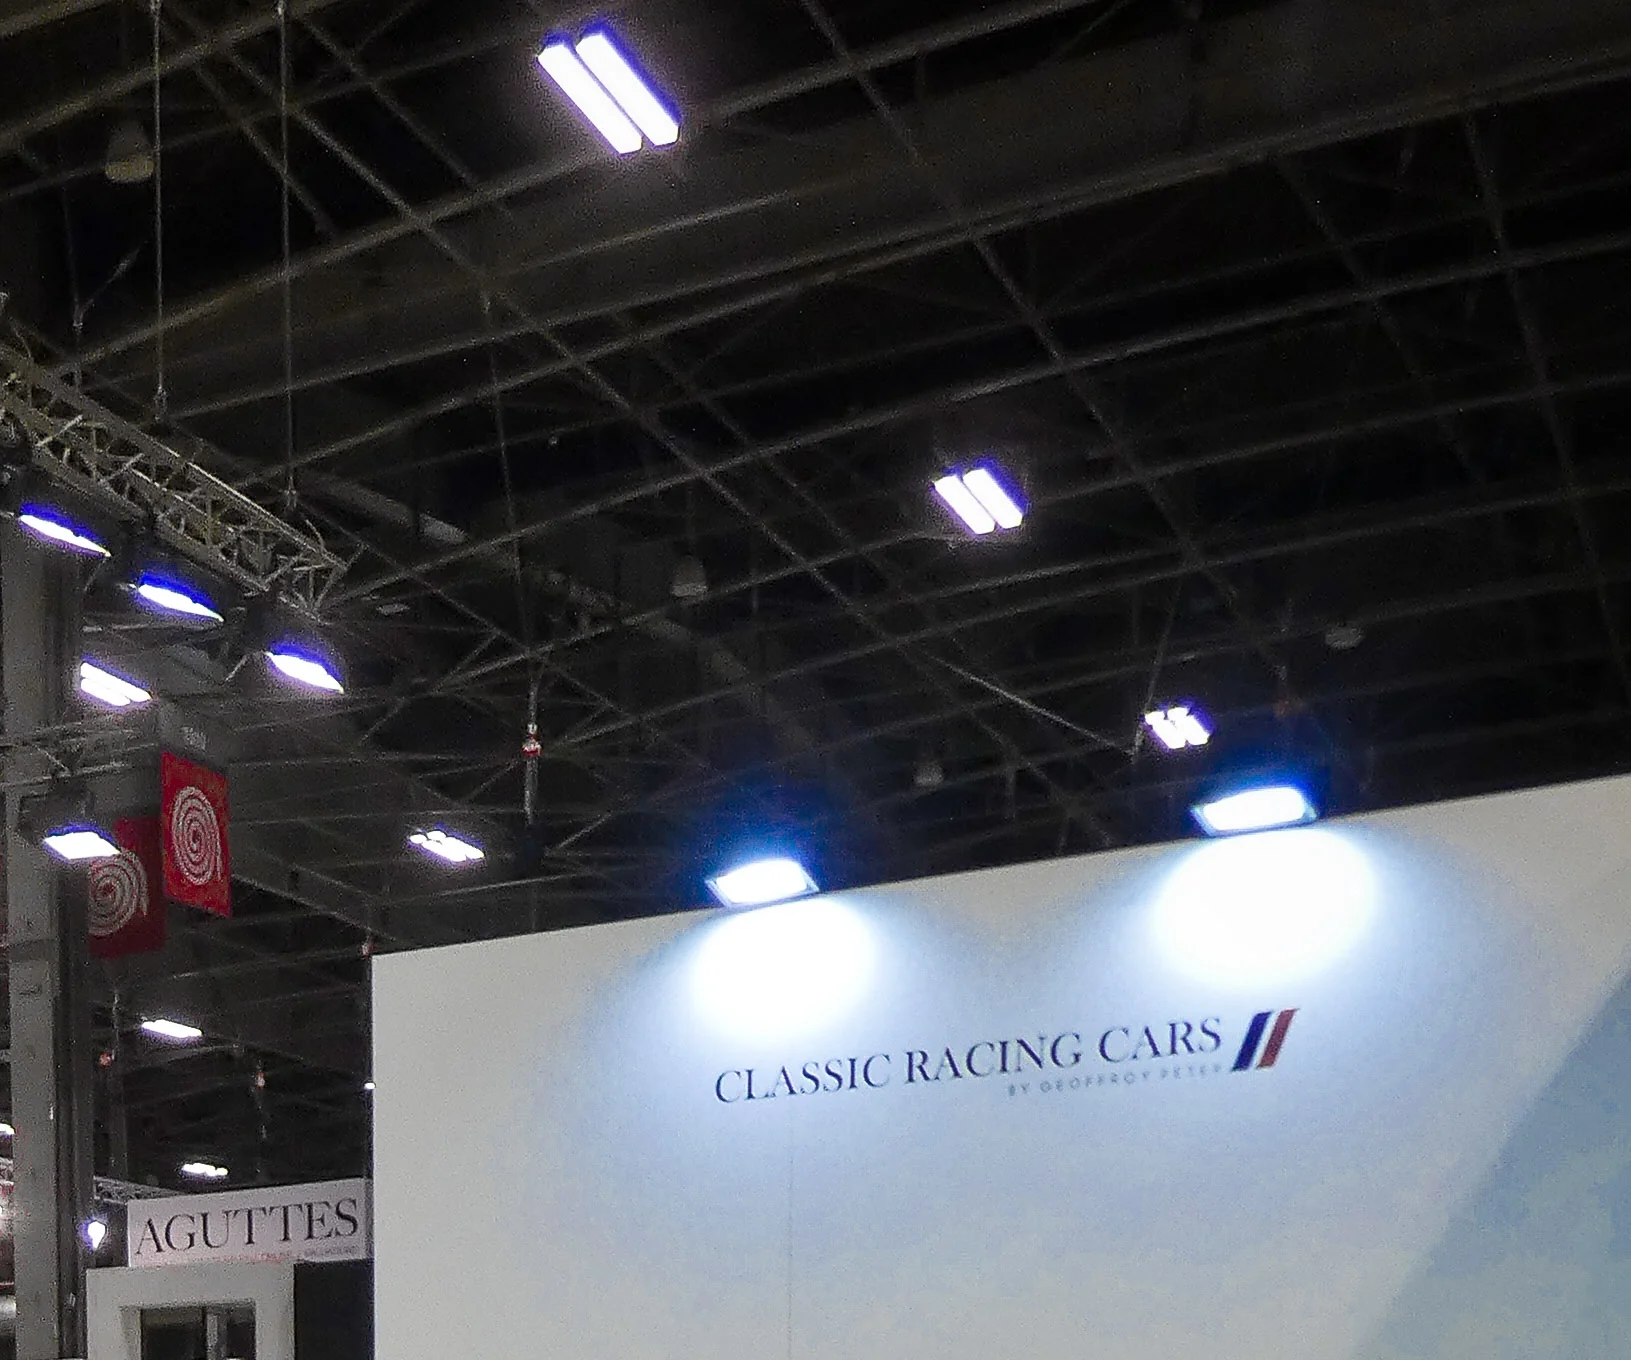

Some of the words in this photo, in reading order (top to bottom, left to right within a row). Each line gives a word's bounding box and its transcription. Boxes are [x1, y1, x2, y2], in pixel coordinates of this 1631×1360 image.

[715, 1053, 892, 1103] CLASSIC
[904, 1031, 1082, 1084] RACING
[1098, 1016, 1222, 1063] CARS
[136, 1197, 359, 1255] AGUTTES
